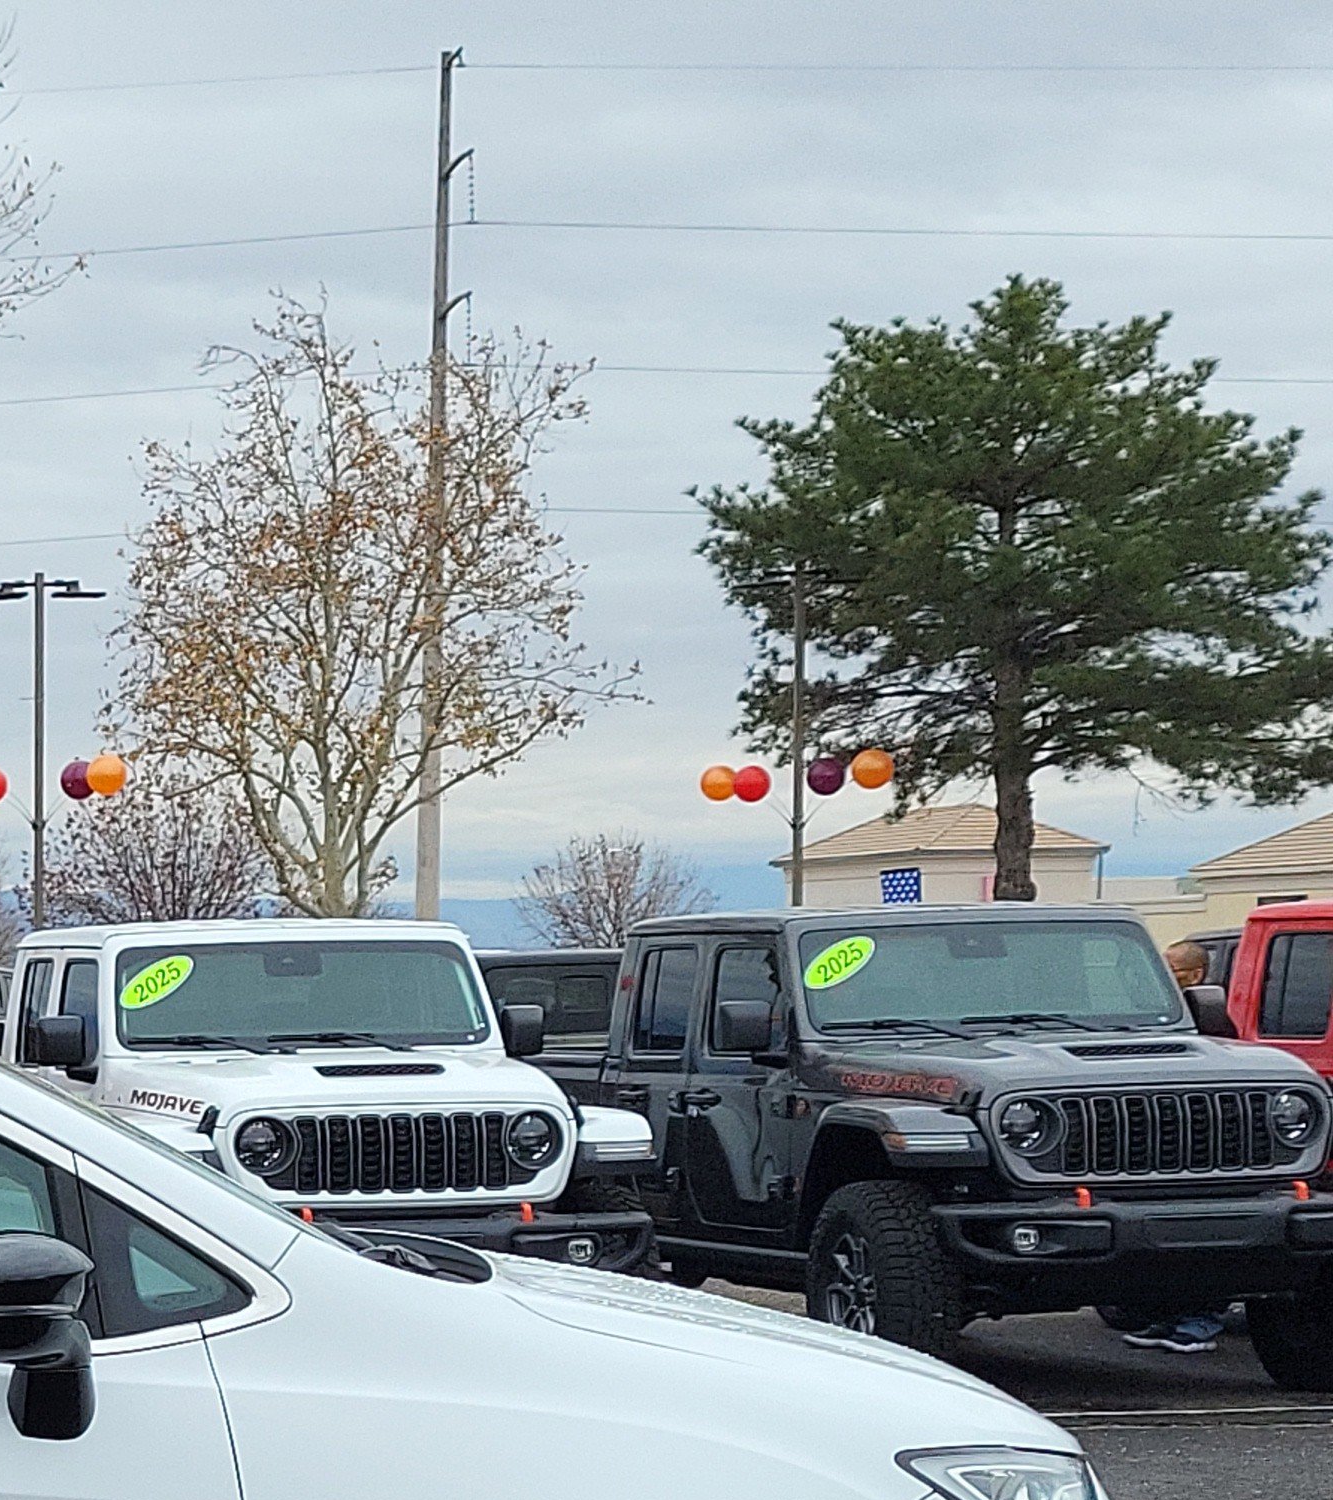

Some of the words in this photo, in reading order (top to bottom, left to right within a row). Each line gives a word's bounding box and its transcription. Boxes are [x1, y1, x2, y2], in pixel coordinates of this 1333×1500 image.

[133, 961, 182, 1003] 2025
[817, 942, 864, 983] 2025
[129, 1089, 205, 1115] MOJAVE
